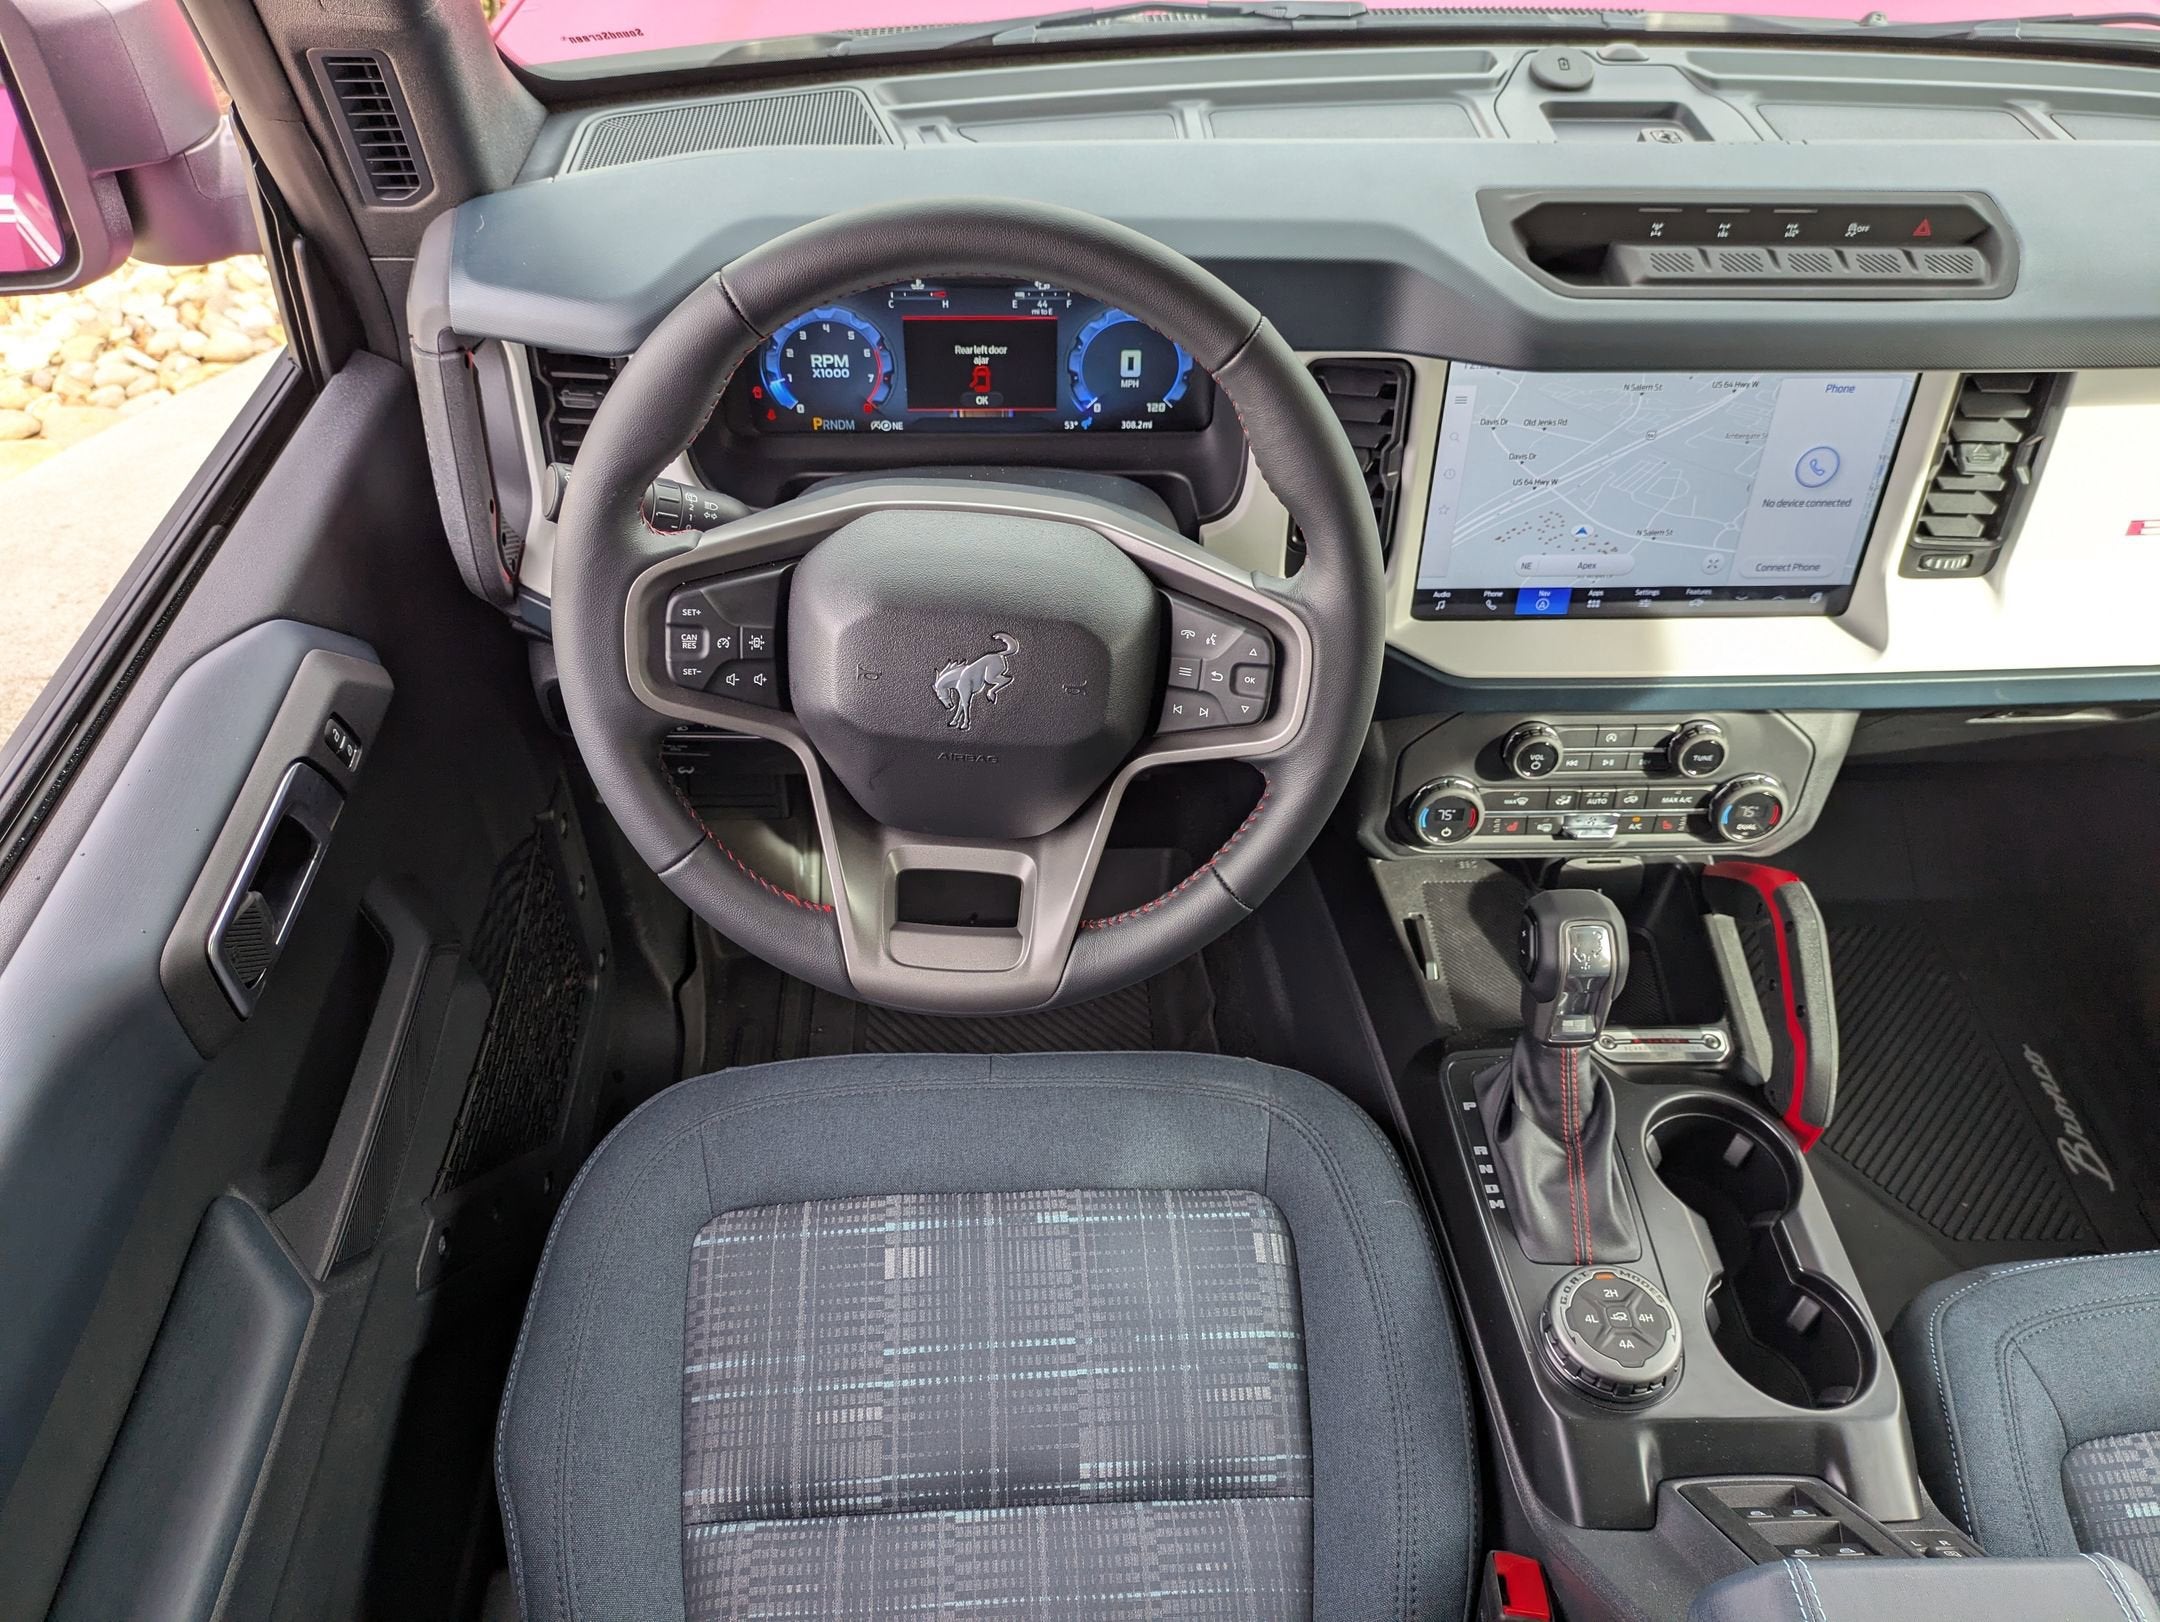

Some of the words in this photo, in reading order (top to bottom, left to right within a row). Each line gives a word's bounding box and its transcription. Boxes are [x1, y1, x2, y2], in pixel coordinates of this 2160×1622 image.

[1857, 225, 1870, 233] OFF
[888, 300, 895, 309] C
[942, 300, 949, 309] H
[1012, 300, 1018, 309] E
[1037, 300, 1048, 309] 44
[1066, 300, 1072, 309] F
[823, 323, 830, 333] 4
[799, 331, 807, 340] 3
[848, 331, 855, 340] 5
[786, 349, 794, 358] 2
[863, 349, 871, 358] 6
[954, 345, 973, 355] Rear
[973, 345, 988, 355] left
[988, 345, 1008, 355] door
[810, 354, 849, 368] RPM
[973, 356, 989, 366] ajar
[1120, 349, 1142, 378] 0
[787, 374, 793, 383] 1
[812, 369, 850, 379] X1000
[867, 374, 875, 383] 7
[1120, 379, 1140, 388] MPH
[1631, 383, 1653, 391] Salem
[1654, 383, 1663, 391] St
[1712, 381, 1722, 389] US
[1723, 381, 1734, 389] 64
[1735, 381, 1751, 391] Hwy
[1752, 381, 1760, 389] W
[1825, 383, 1856, 394] Phone
[975, 395, 989, 406] OK
[796, 404, 805, 414] 0
[1093, 403, 1101, 413] 0
[1146, 403, 1166, 413] 120
[892, 421, 904, 431] NE
[1480, 418, 1499, 426] Davis
[1500, 418, 1508, 426] Dr
[1523, 418, 1536, 427] Old
[1537, 418, 1558, 427] Jenks
[1559, 418, 1568, 427] Rd
[1508, 453, 1527, 461] Davis
[1528, 453, 1537, 461] Dr
[1512, 478, 1522, 486] US
[1523, 478, 1533, 486] 64
[1534, 478, 1550, 488] Hwy
[1551, 478, 1558, 486] W
[688, 503, 694, 511] 2
[1762, 499, 1776, 508] No
[1777, 499, 1804, 508] device
[1805, 499, 1852, 508] connected
[1643, 529, 1664, 537] Salem
[1665, 529, 1673, 537] St
[1520, 561, 1533, 570] NE
[1577, 561, 1597, 570] Apex
[1755, 563, 1791, 572] Connect
[1792, 563, 1821, 572] Phone
[1433, 590, 1450, 598] Audio
[1483, 590, 1503, 598] Phone
[1588, 589, 1604, 598] Apps
[1634, 588, 1661, 598] Settings
[1686, 588, 1713, 596] Features
[682, 608, 702, 617] SET+
[681, 633, 698, 641] CAN
[682, 642, 697, 650] RES
[683, 668, 702, 676] SET-
[1244, 676, 1256, 685] OK
[937, 752, 999, 764] AIRBAG
[1692, 754, 1714, 762] TUNE
[1628, 823, 1642, 831] A/C
[1463, 1102, 1477, 1111] P
[2022, 1043, 2115, 1192] Bronco
[1473, 1146, 1489, 1155] R
[1479, 1164, 1494, 1174] N
[1485, 1184, 1500, 1194] D
[1489, 1200, 1505, 1209] M
[1619, 1270, 1666, 1304] MODES
[1603, 1289, 1619, 1298] 2H
[1585, 1314, 1599, 1324] 4L
[1638, 1313, 1654, 1323] 4H
[1619, 1339, 1635, 1349] 4A
